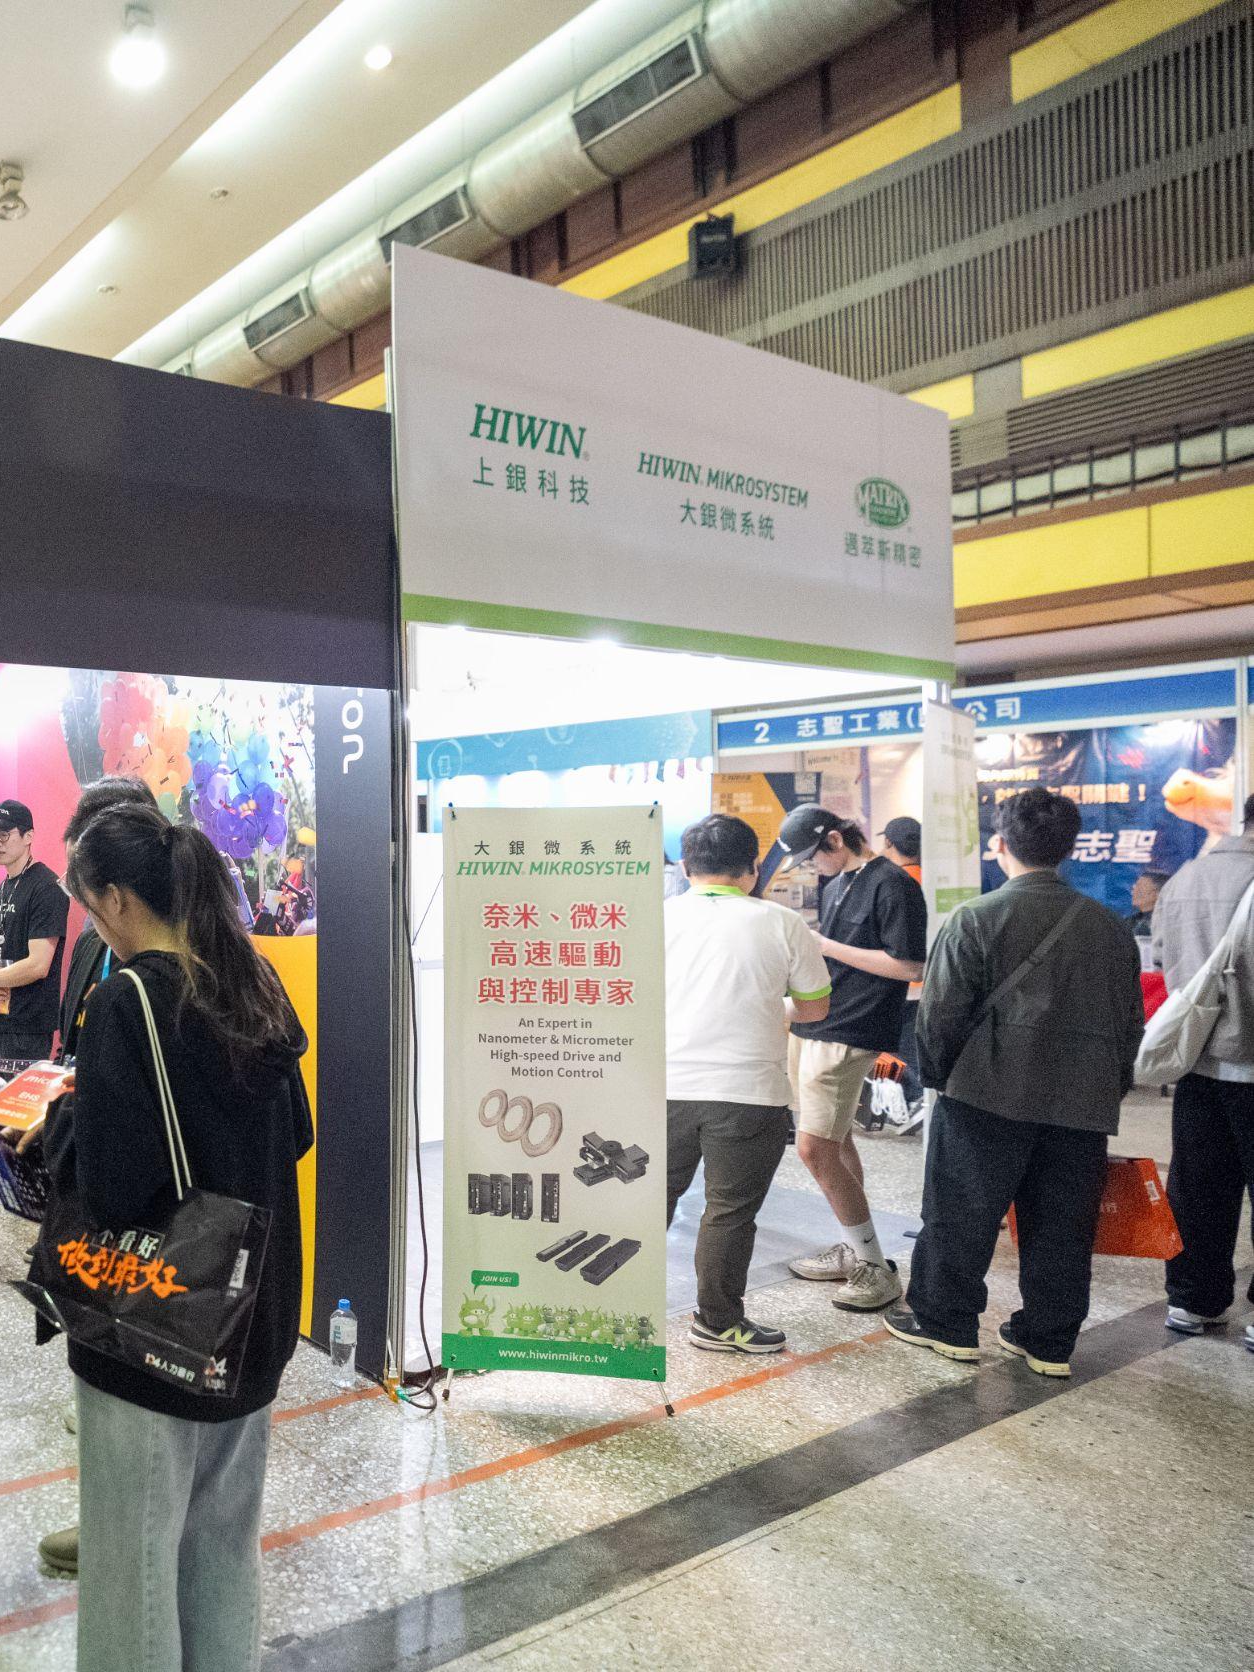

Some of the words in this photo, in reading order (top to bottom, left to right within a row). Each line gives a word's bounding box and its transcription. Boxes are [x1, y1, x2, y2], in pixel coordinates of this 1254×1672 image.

[469, 403, 587, 459] HIWIN
[473, 457, 591, 506] 上銀科技
[637, 452, 702, 487] HIWIN
[706, 469, 809, 509] MIKROSYSTEM
[679, 498, 775, 541] 大銀微系統
[754, 722, 771, 744] 2
[797, 707, 923, 740] 志聖工業(
[474, 840, 632, 856] 大銀微系統
[1070, 829, 1158, 864] 志聖
[456, 861, 523, 876] HIWIN
[529, 861, 651, 876] MIKROSYSTEM
[482, 902, 627, 930] 奈米、微米
[489, 940, 622, 968] 高速驅動
[477, 978, 635, 1006] 與控制專家
[518, 1018, 535, 1028] An
[537, 1018, 578, 1031] Expert
[580, 1018, 593, 1029] in
[478, 1033, 547, 1045] Nanometer
[549, 1034, 560, 1045] &
[562, 1035, 634, 1046] Micrometer
[490, 1050, 560, 1062] High-speed
[562, 1050, 595, 1062] Drive
[598, 1052, 622, 1063] and
[511, 1066, 554, 1079] Motion
[557, 1067, 604, 1080] Control
[480, 1275, 498, 1283] JOIN
[499, 1349, 609, 1365] www.hiwinmikro.tw
